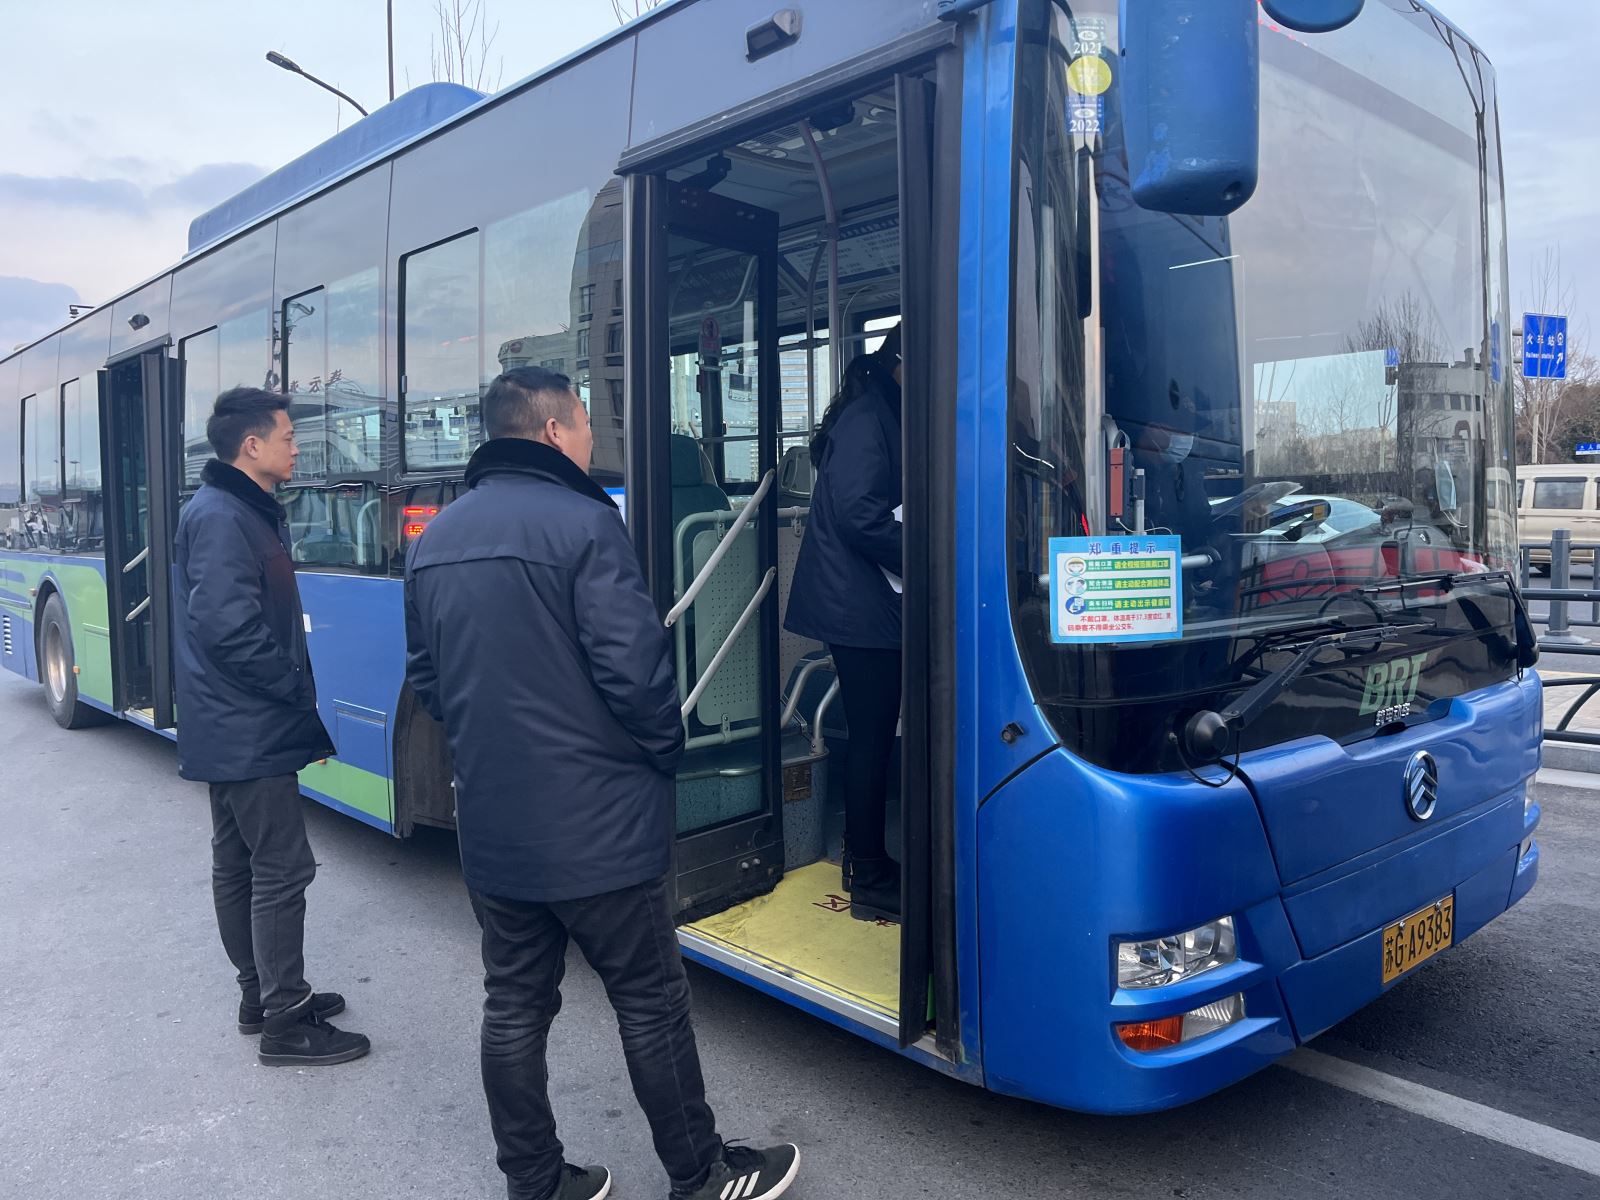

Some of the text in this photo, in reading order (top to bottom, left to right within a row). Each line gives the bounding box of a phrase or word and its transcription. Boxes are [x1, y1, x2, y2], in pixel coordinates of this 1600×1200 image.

[1073, 42, 1102, 55] 2021
[1069, 119, 1100, 133] 2022
[1526, 333, 1555, 346] 火车站
[1088, 542, 1156, 556] 郑重提示
[1358, 652, 1428, 716] BRT
